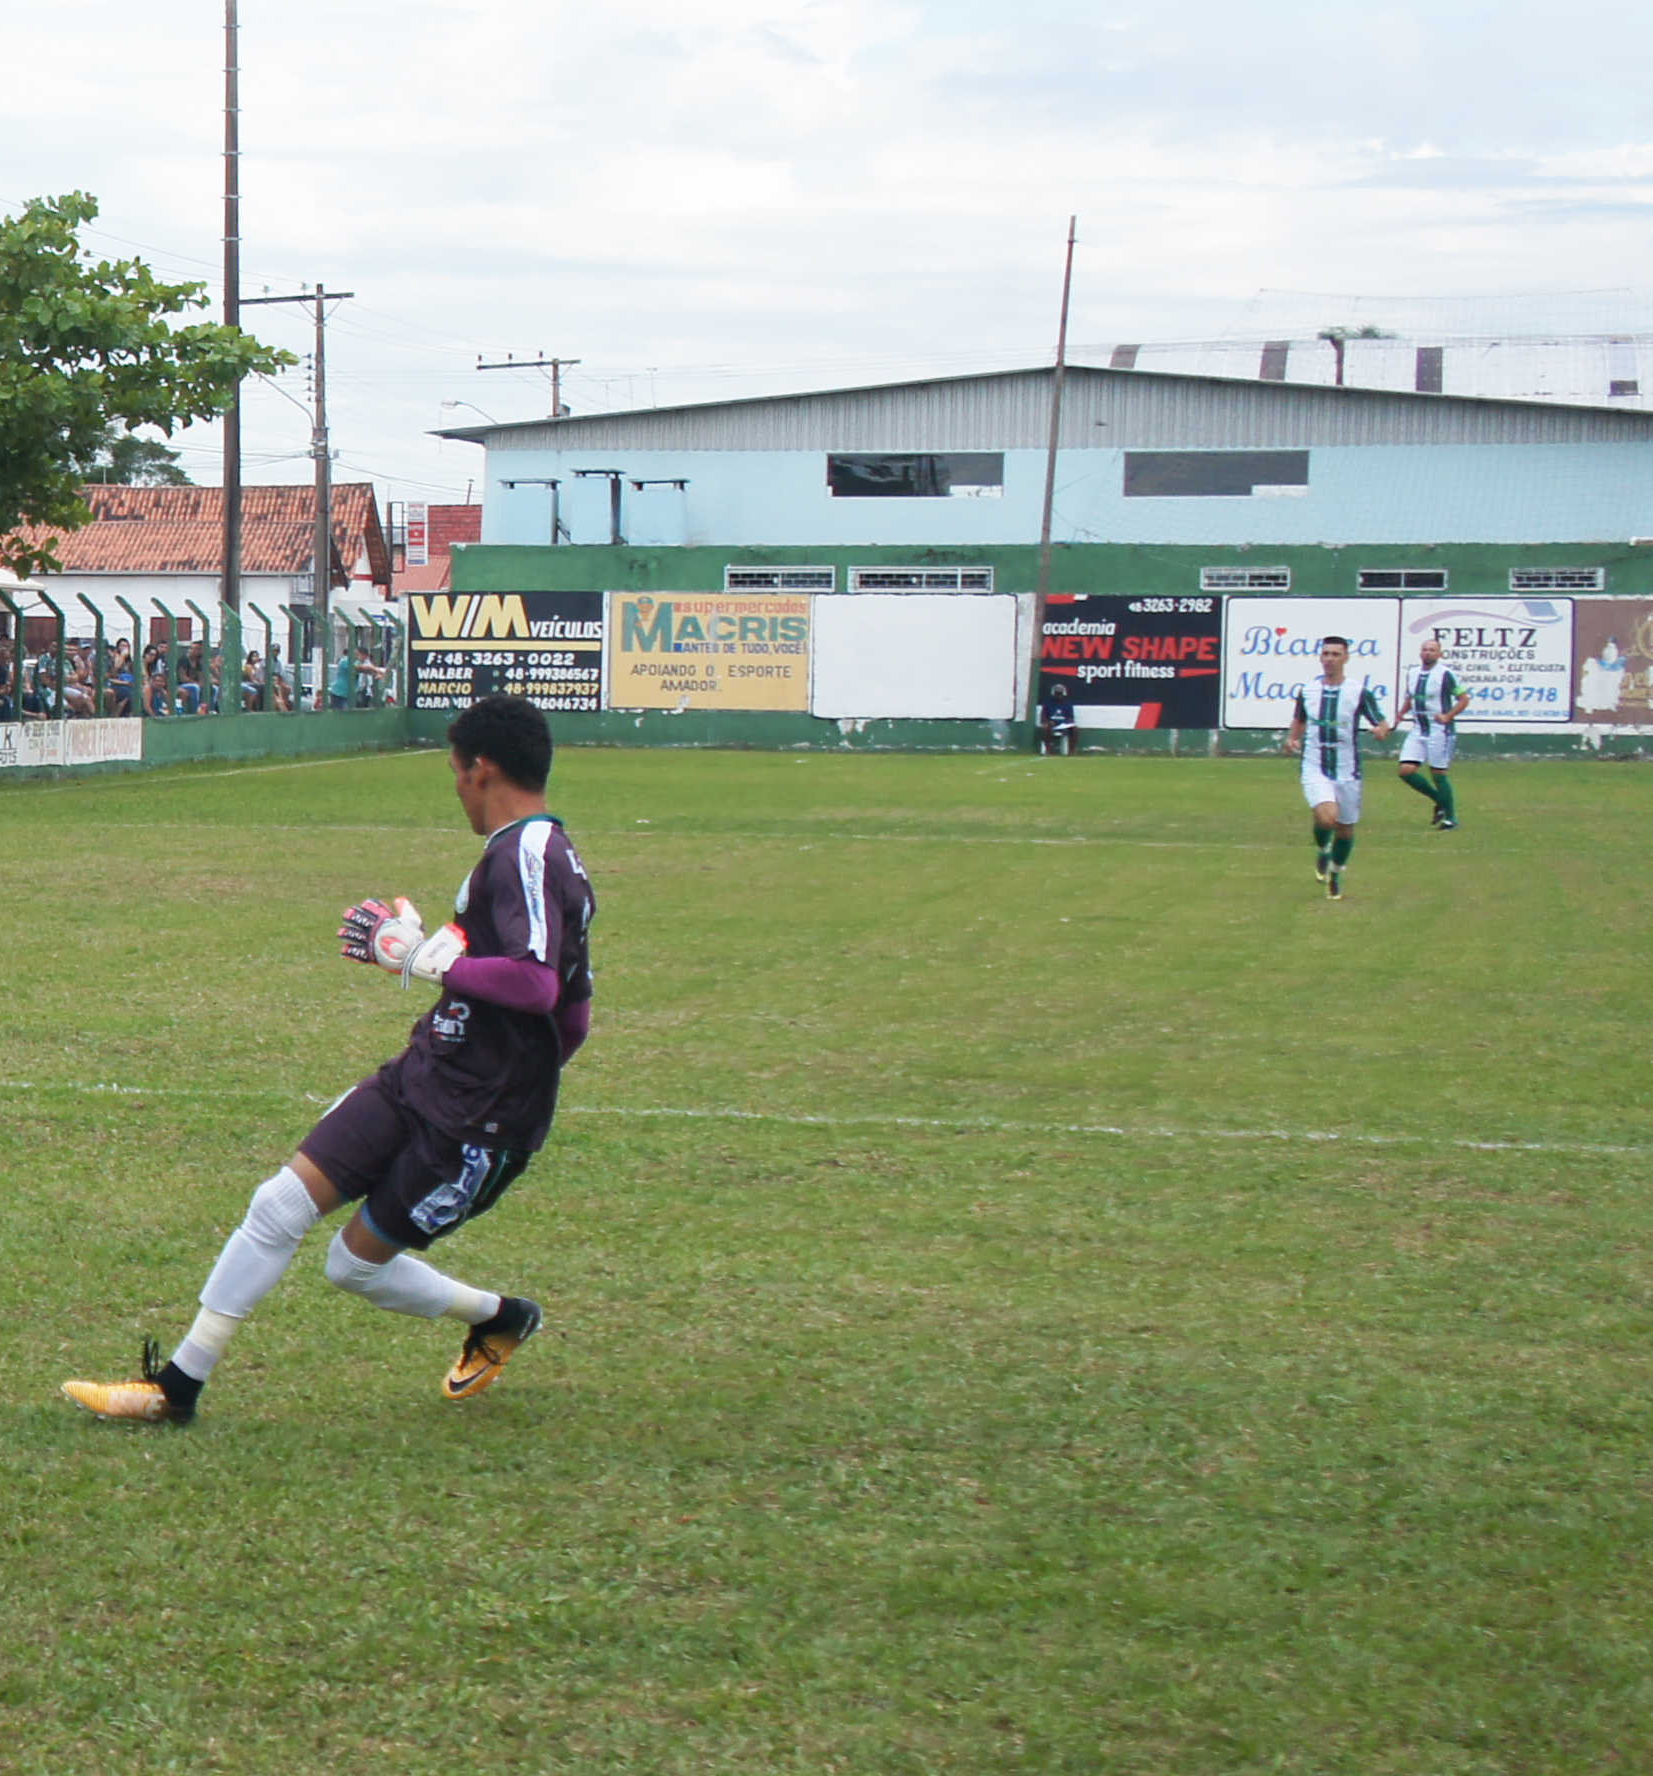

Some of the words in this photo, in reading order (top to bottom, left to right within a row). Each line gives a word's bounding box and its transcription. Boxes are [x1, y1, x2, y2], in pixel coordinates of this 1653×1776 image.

[683, 600, 807, 615] supermercados
[1042, 617, 1116, 635] academia
[1433, 628, 1537, 648] FELTZ
[724, 643, 736, 654] DE
[1041, 637, 1114, 659] NEW
[1122, 636, 1219, 660] SHAPE
[1442, 648, 1535, 662] ONSTRUÇÕES
[417, 667, 473, 680] WALBER
[631, 664, 696, 677] APOIANDO
[728, 665, 792, 678] ESPORTE
[1077, 662, 1122, 684] sport
[1123, 660, 1175, 679] fitness
[417, 682, 472, 695] MARCIO
